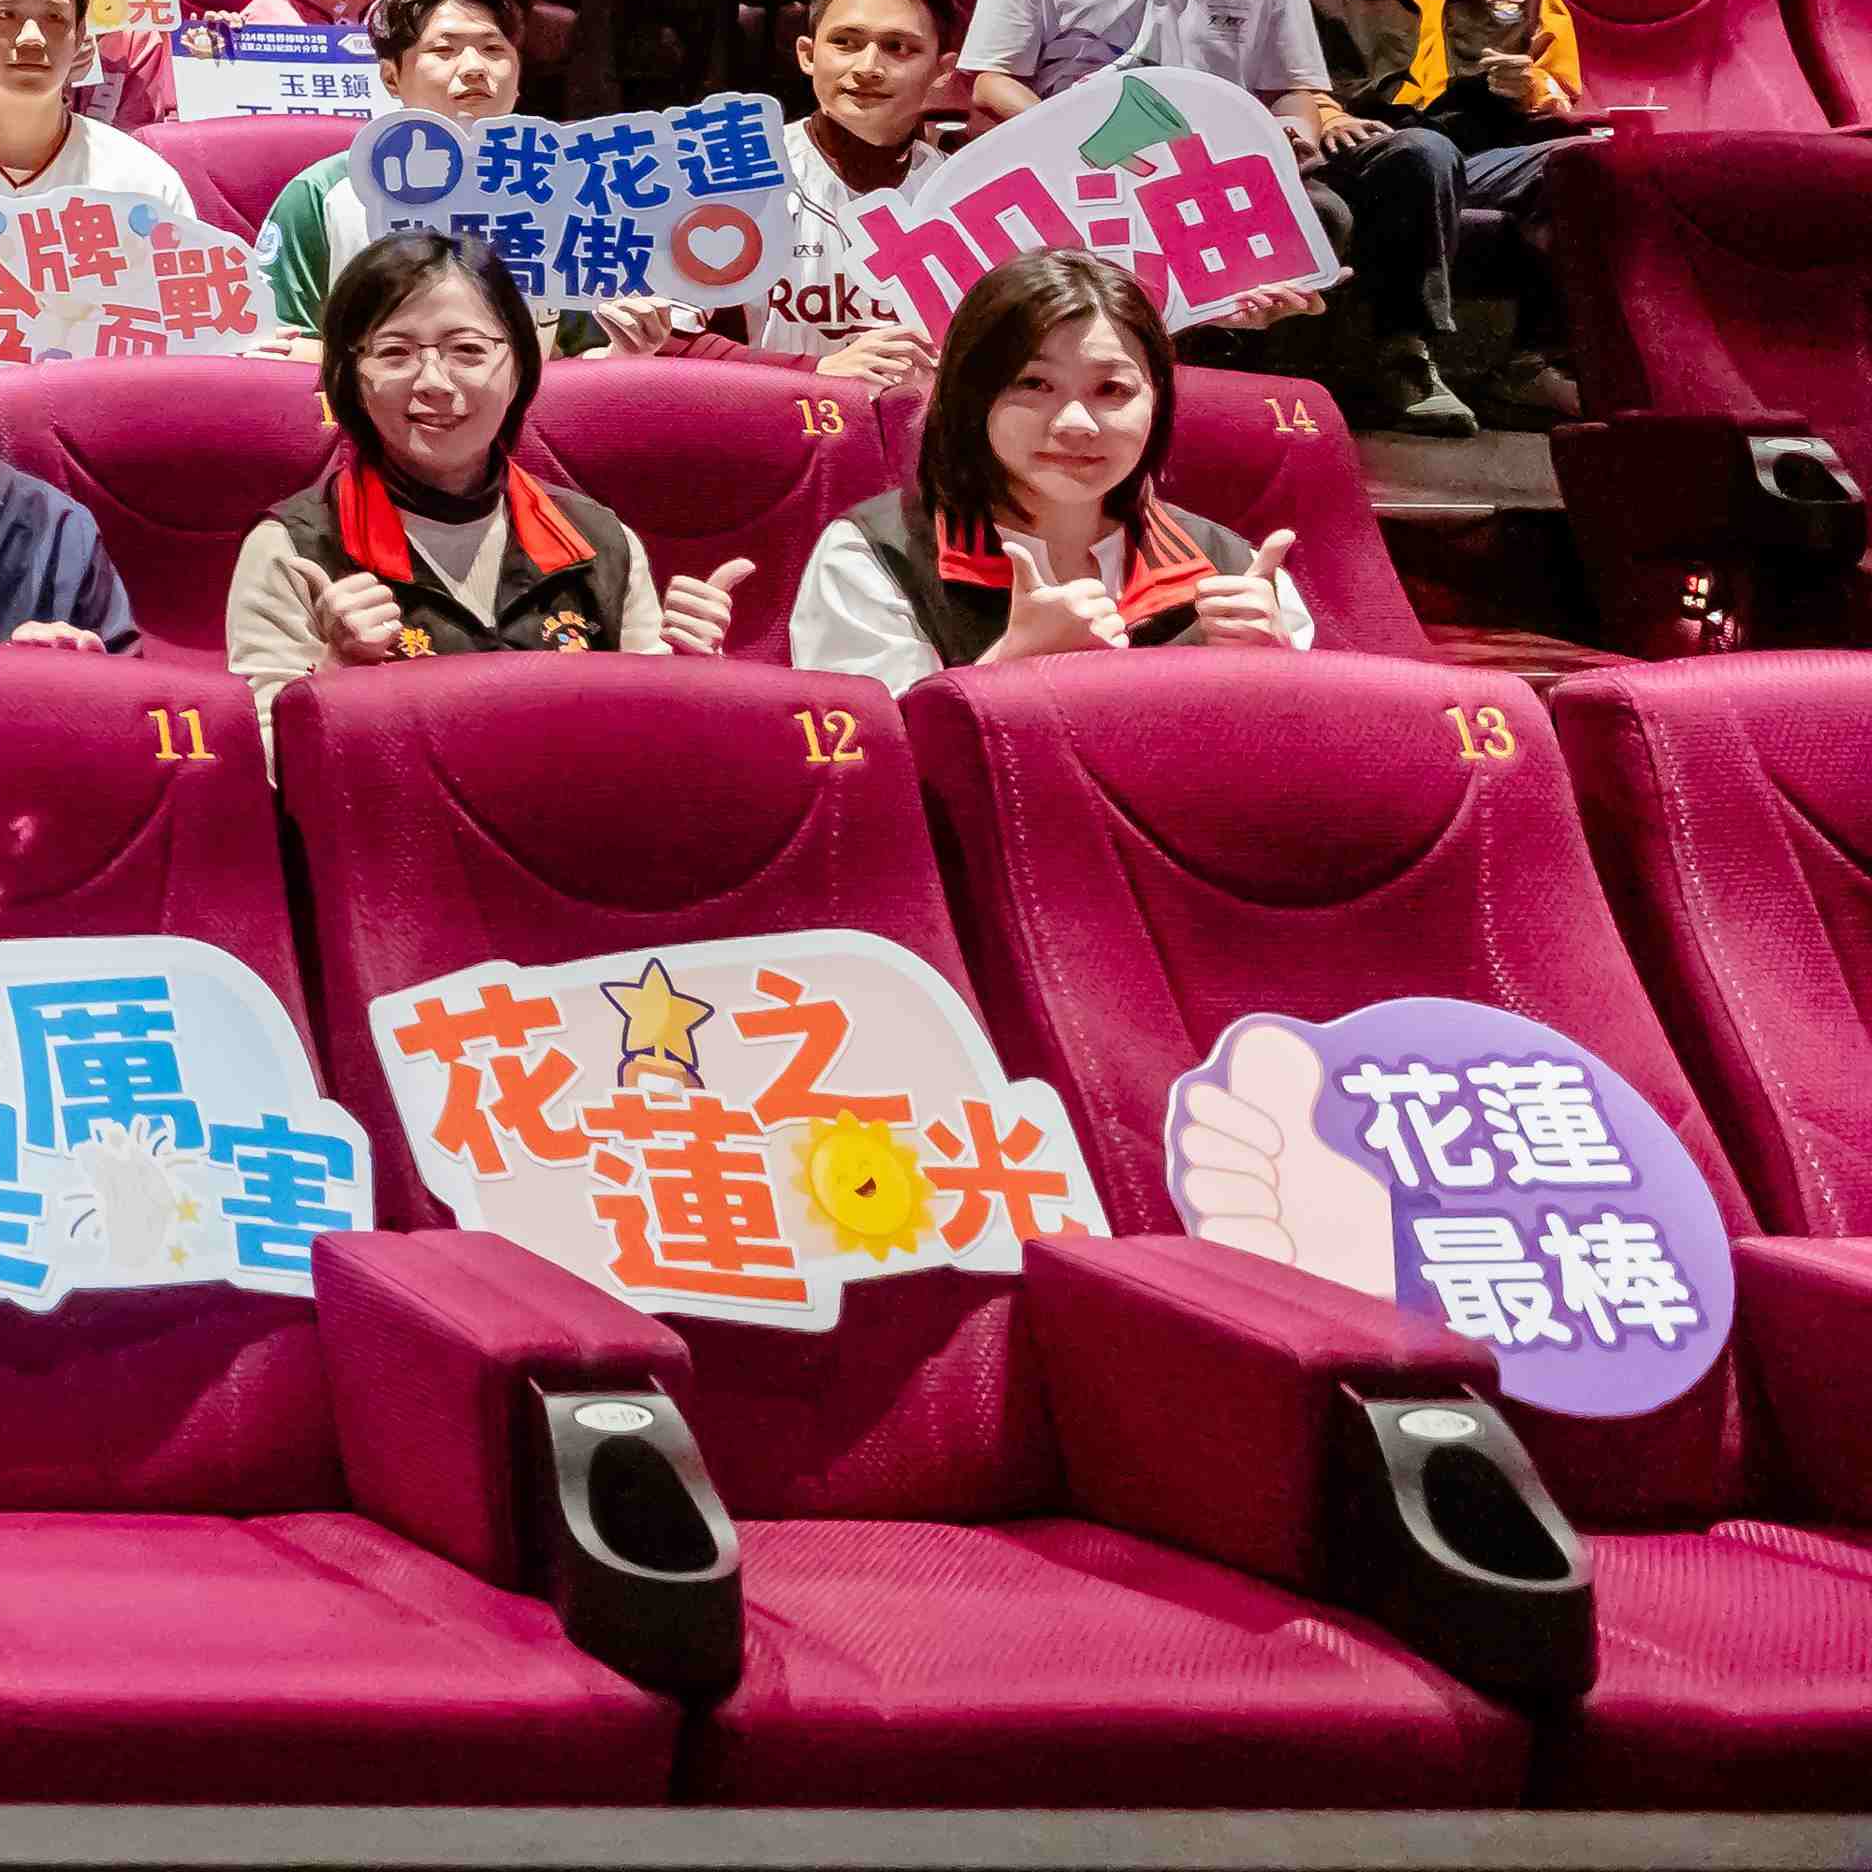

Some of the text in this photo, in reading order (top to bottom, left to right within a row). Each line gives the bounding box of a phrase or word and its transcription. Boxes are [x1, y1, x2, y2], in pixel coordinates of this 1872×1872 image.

[279, 73, 371, 98] 玉里鎮
[475, 100, 785, 216] 我花蓮
[389, 211, 656, 299] 驕傲
[858, 133, 1323, 346] 加油
[795, 399, 846, 436] 13
[1264, 398, 1319, 434] 14
[147, 708, 216, 762] 11
[794, 709, 864, 765] 12
[1444, 705, 1517, 762] 13
[1338, 1058, 1634, 1189] 花蓮
[1414, 1211, 1700, 1347] 最棒
